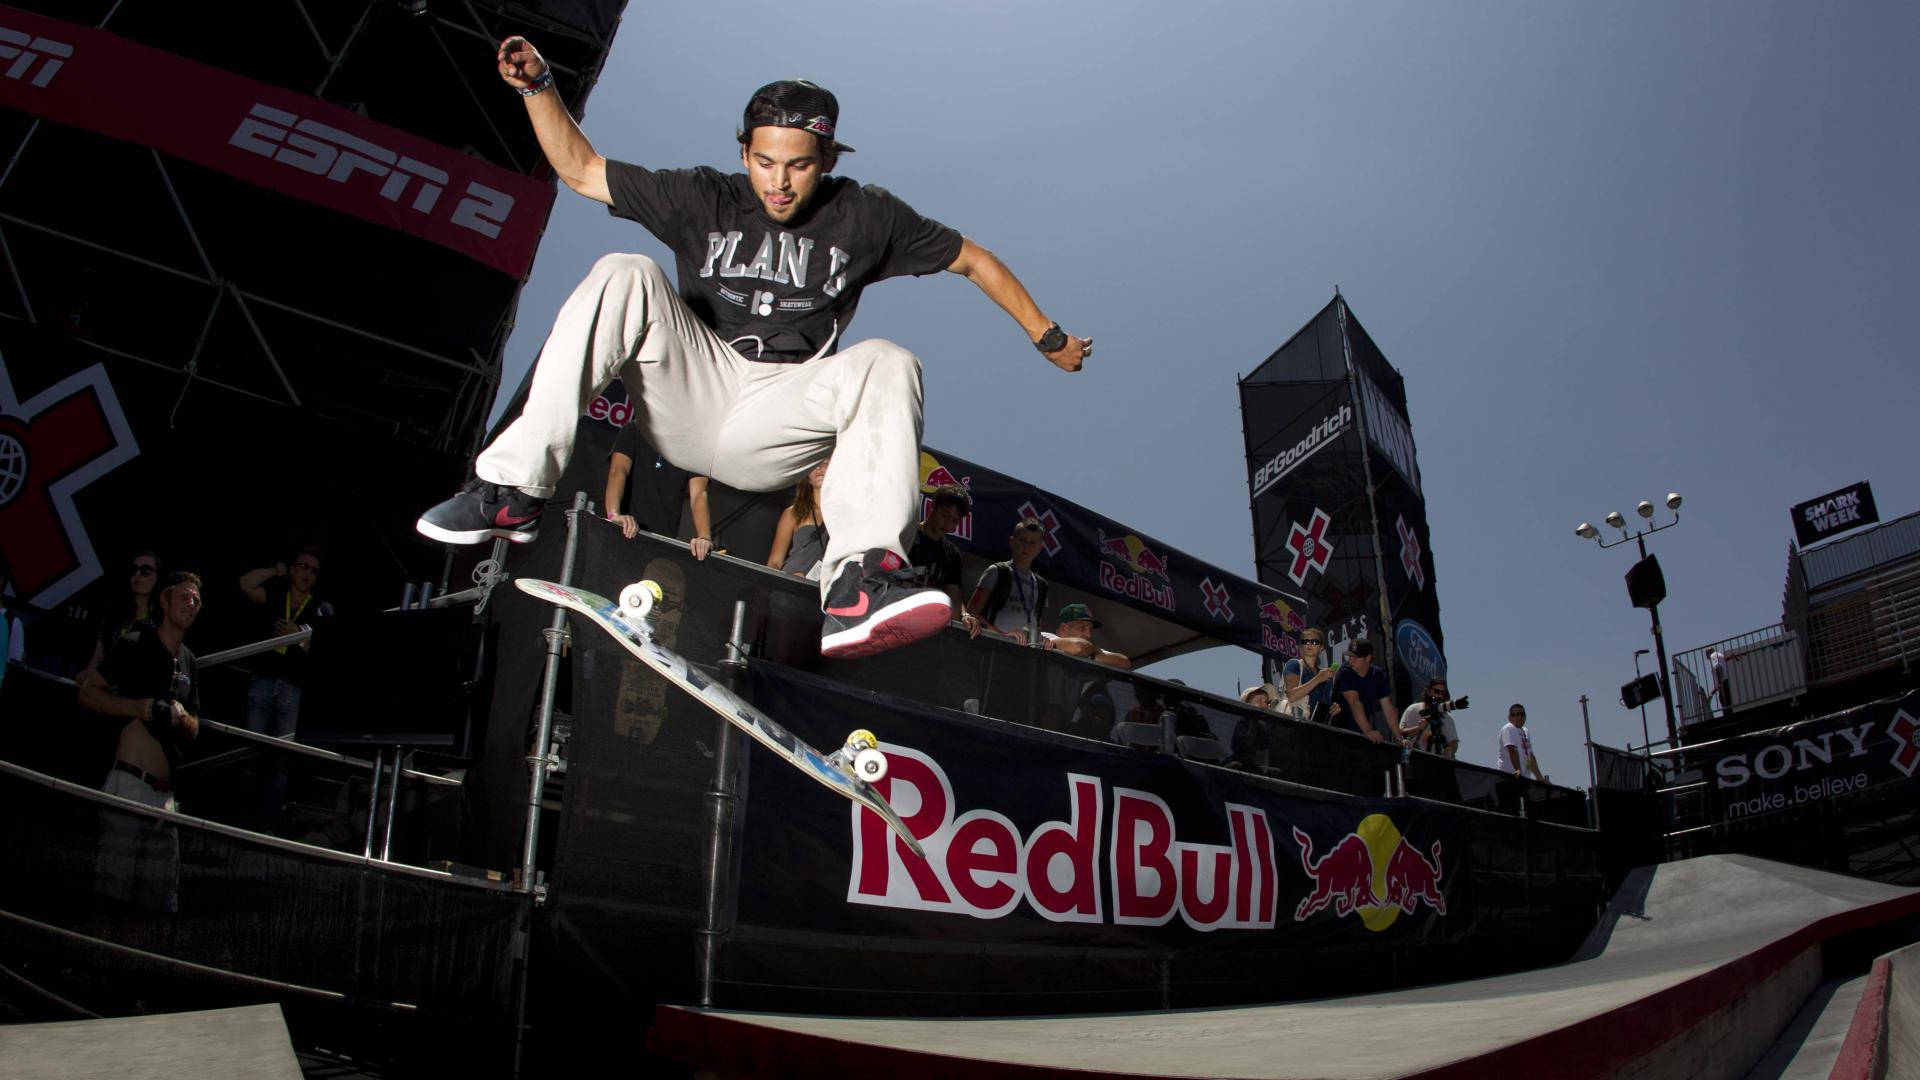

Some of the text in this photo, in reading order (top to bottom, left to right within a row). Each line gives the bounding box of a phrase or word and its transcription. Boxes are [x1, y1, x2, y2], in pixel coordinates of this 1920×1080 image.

[228, 102, 515, 240] ESPN 2
[700, 231, 815, 289] PLAN
[584, 393, 635, 428] ed
[1253, 405, 1352, 492] BFGoodrich
[1804, 490, 1861, 522] SHARK
[1811, 504, 1861, 533] WEEK
[1408, 629, 1438, 677] Ford
[1716, 721, 1875, 790] SONY
[1728, 772, 1869, 818] make.believe
